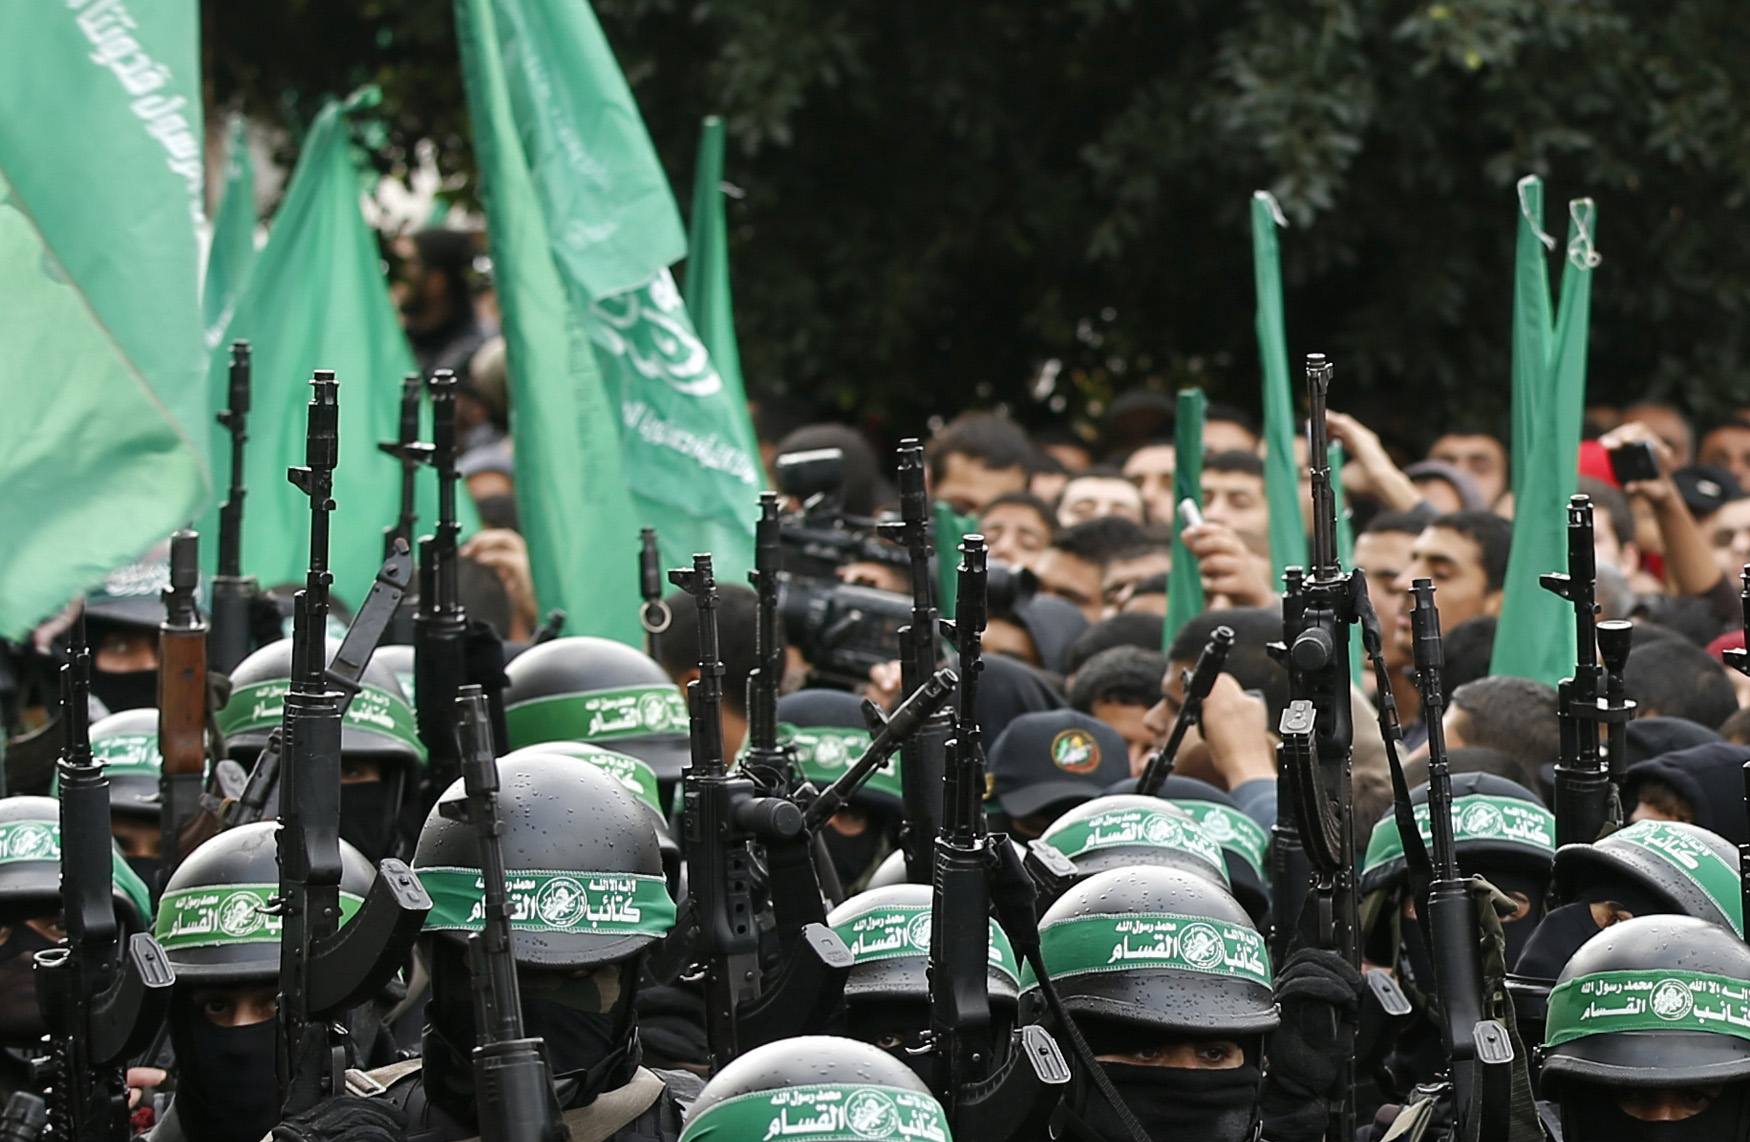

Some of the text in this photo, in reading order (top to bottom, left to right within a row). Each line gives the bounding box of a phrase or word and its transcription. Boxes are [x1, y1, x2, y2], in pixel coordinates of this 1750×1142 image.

[1083, 823, 1142, 851] القسام
[1502, 817, 1551, 846] كتائب
[466, 894, 641, 928] كتائب القام
[167, 908, 218, 939] القسام
[1115, 920, 1133, 932] الله
[1132, 919, 1154, 935] رسول
[1154, 920, 1177, 931] محمد
[851, 927, 908, 956] القسام
[1107, 934, 1265, 977] كتائب القسام
[1595, 979, 1622, 996] رسول
[1624, 980, 1653, 991] محمد
[1689, 978, 1706, 992] الله
[1580, 996, 1646, 1020] القسام
[790, 1090, 815, 1106] رسول
[816, 1090, 842, 1101] محمد
[763, 1104, 846, 1142] القسام
